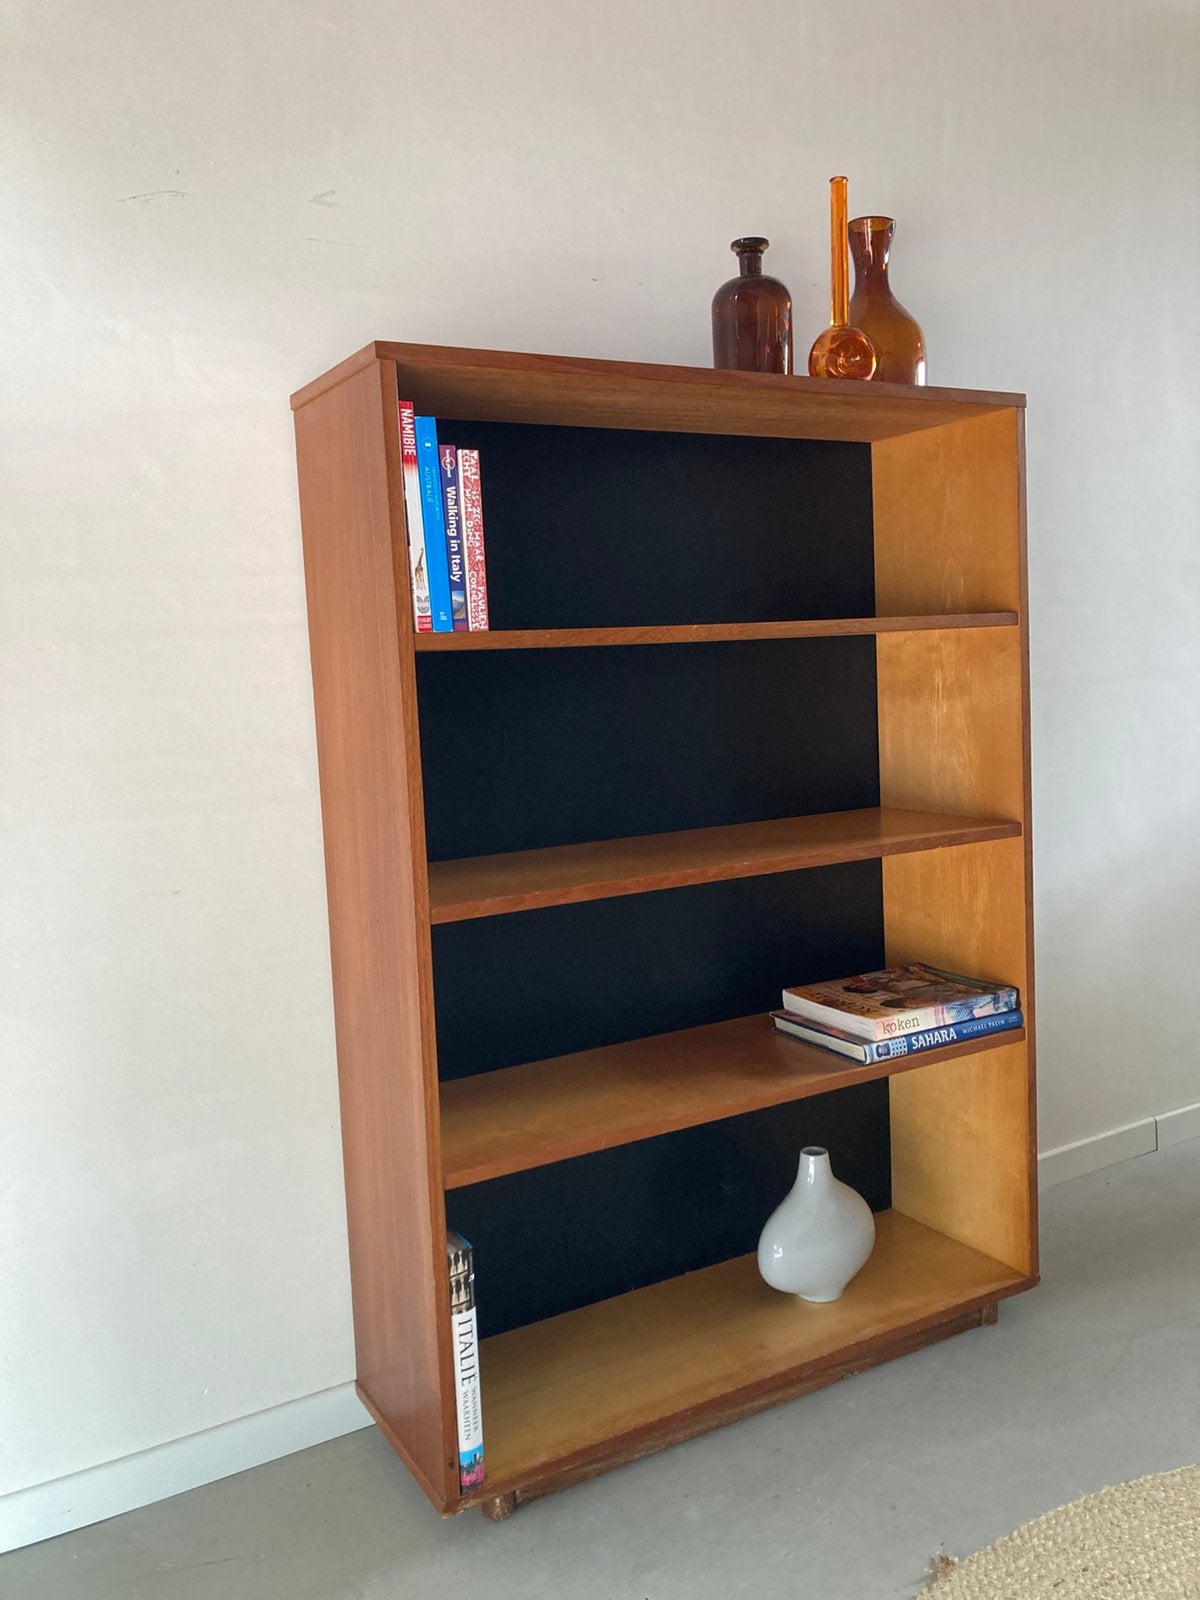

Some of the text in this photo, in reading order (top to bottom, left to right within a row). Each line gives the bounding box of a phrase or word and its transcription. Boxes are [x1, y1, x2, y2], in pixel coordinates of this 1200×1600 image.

[401, 408, 416, 456] NAMIBIE
[462, 450, 472, 479] ECHT
[469, 450, 479, 482] TAAL
[474, 531, 484, 561] MAAR
[446, 486, 462, 583] Walking in Italy
[882, 1016, 920, 1034] koken
[912, 1027, 957, 1050] SAHARA
[962, 1024, 987, 1034] MICHAEL
[988, 1019, 1005, 1029] PALIN
[458, 1318, 477, 1387] ITALIË
[462, 1391, 471, 1441] WAARHEEN
[471, 1388, 479, 1432] WANNEER
